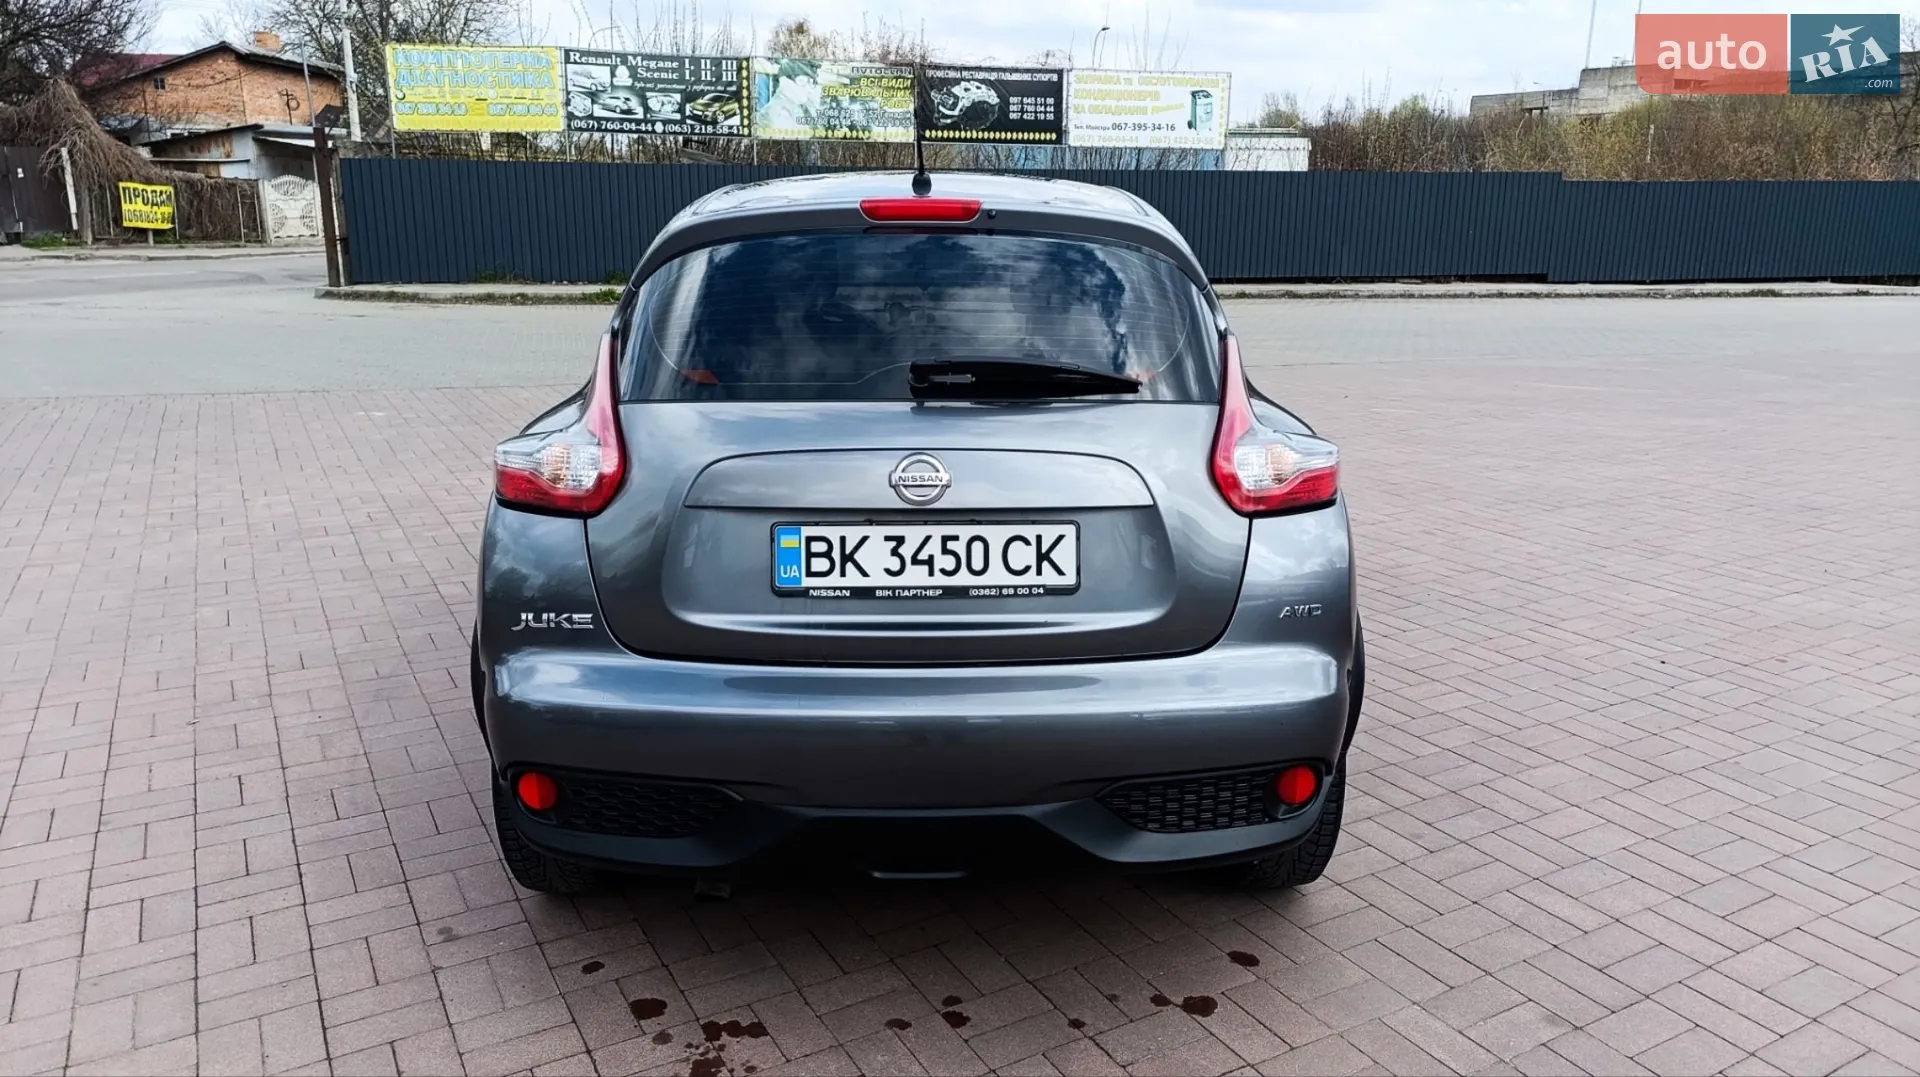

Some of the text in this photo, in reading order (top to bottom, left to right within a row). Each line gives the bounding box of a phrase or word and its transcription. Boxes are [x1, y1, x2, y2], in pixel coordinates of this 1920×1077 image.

[569, 52, 621, 65] Renault
[627, 55, 680, 70] Megane
[722, 60, 737, 71] III
[395, 69, 554, 89] ДІАГНОСТИКА
[637, 67, 680, 79] Scenic
[722, 70, 738, 82] III
[879, 78, 912, 88] ВИДИ
[821, 87, 912, 98] ЗВАРЮВАЛЬНИХ
[570, 120, 598, 130] (067)
[600, 121, 653, 132] 760-04-44
[665, 123, 691, 134] (063)
[694, 125, 743, 135] 218-58-41
[1111, 122, 1176, 132] 067-395-34-16
[122, 186, 172, 209] ПРОДАМ
[898, 475, 943, 484] NISSAN
[805, 534, 1067, 578] BK 3450 CK
[780, 565, 800, 578] UA
[809, 589, 850, 597] NISSAN
[895, 588, 943, 597] ПАРТНЕР
[968, 586, 1044, 596] (0362) 69 00 04
[1279, 603, 1322, 619] AWD
[510, 612, 595, 631] JUKE
